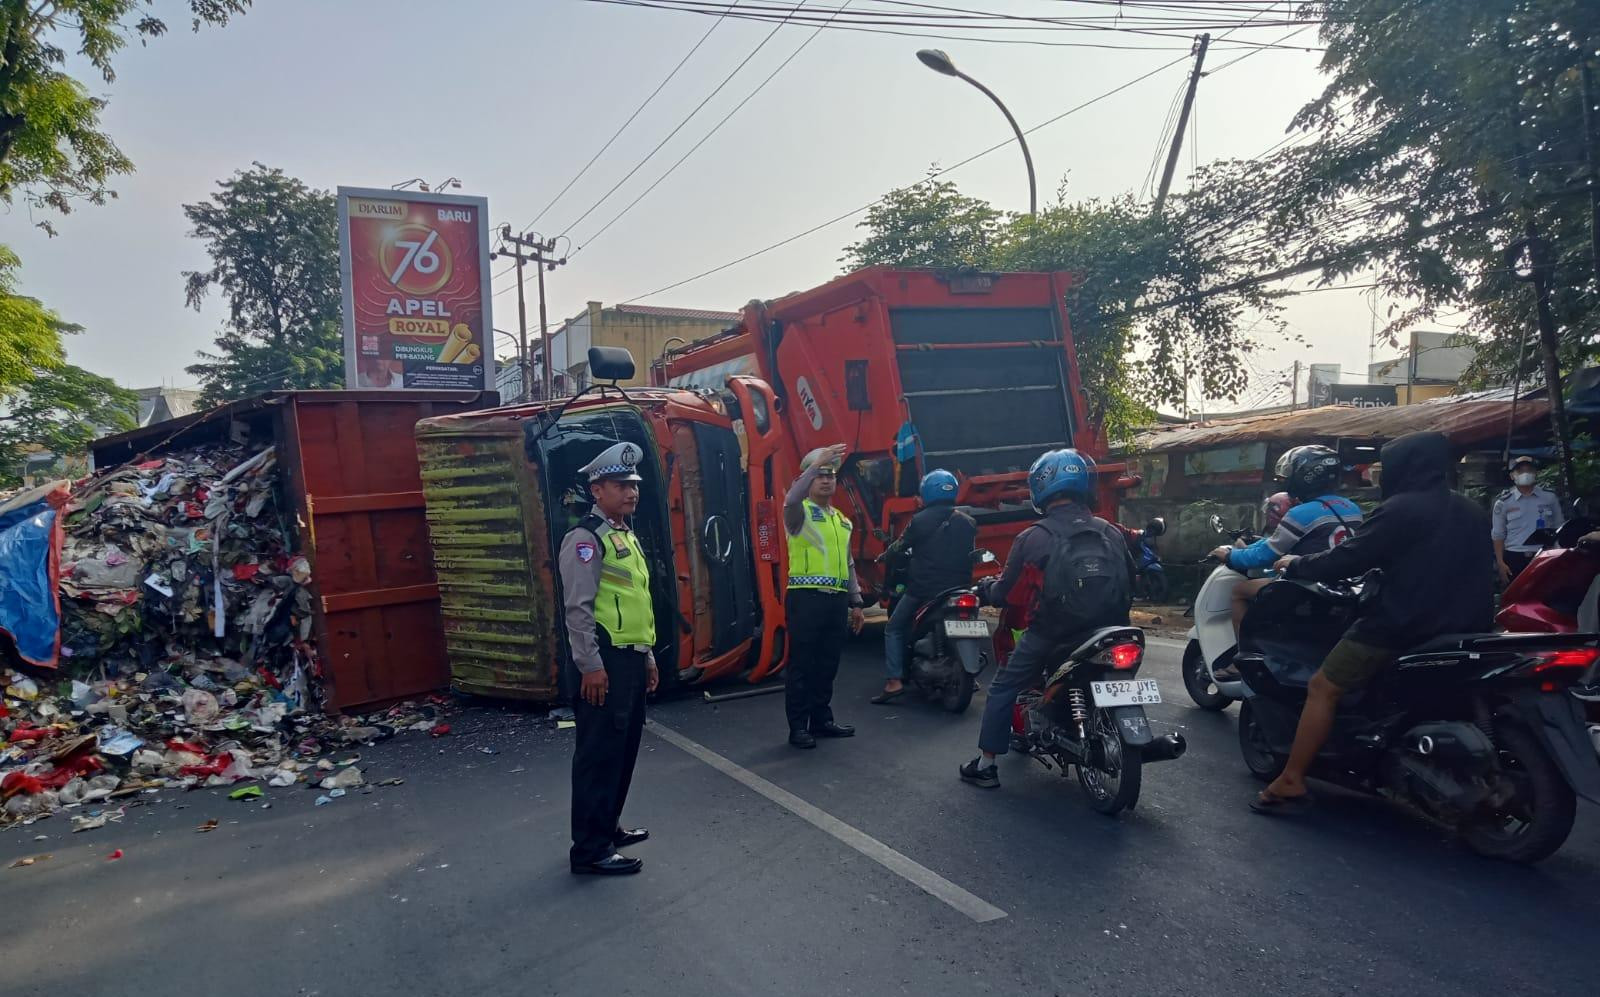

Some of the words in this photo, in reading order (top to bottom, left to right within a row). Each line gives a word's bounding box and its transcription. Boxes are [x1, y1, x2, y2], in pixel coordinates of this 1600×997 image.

[437, 209, 471, 223] BARU
[390, 229, 440, 285] 76
[386, 298, 451, 317] APEL
[395, 320, 446, 334] ROYAL
[395, 345, 433, 353] DIBUNGKUS
[1094, 684, 1102, 694] B
[1105, 682, 1132, 694] 6522
[1136, 680, 1157, 692] UYE
